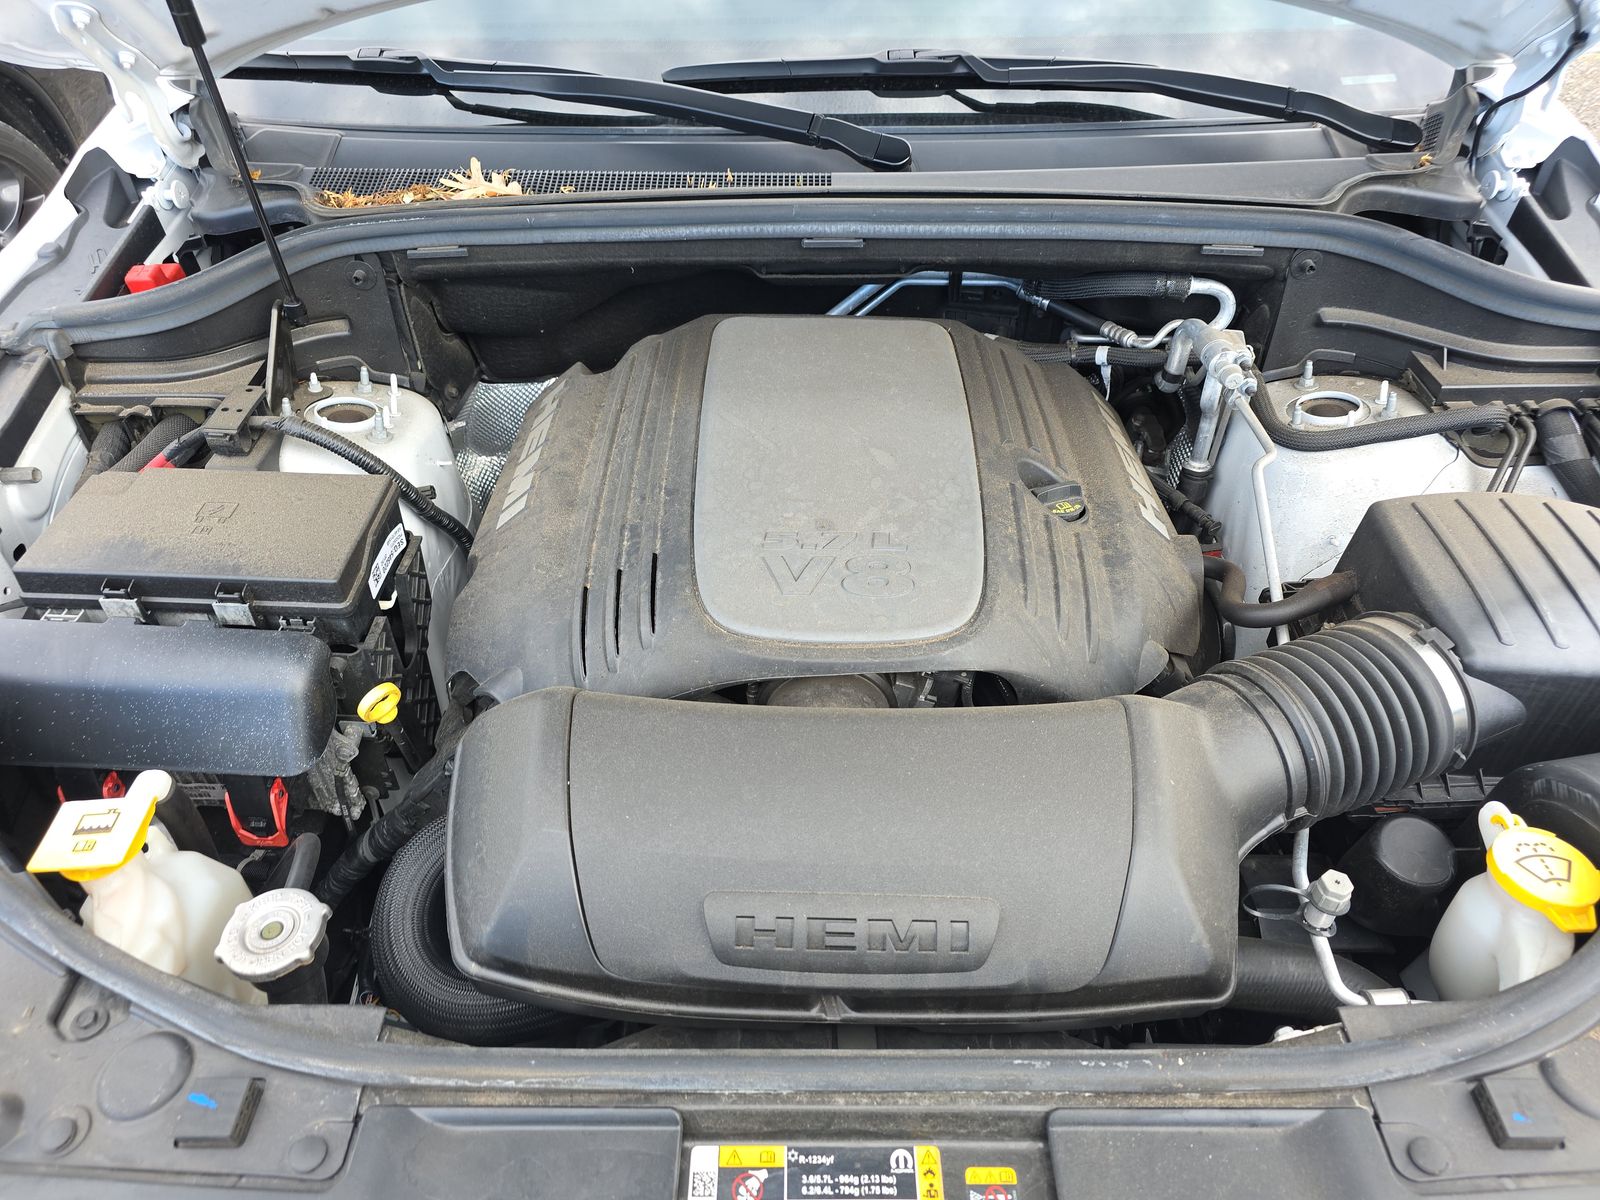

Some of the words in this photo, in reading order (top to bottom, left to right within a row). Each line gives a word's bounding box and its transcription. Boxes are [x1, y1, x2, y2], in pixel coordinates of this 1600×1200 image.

[496, 379, 567, 530] HEMI
[762, 555, 916, 598] V8
[735, 915, 969, 953] HEMI
